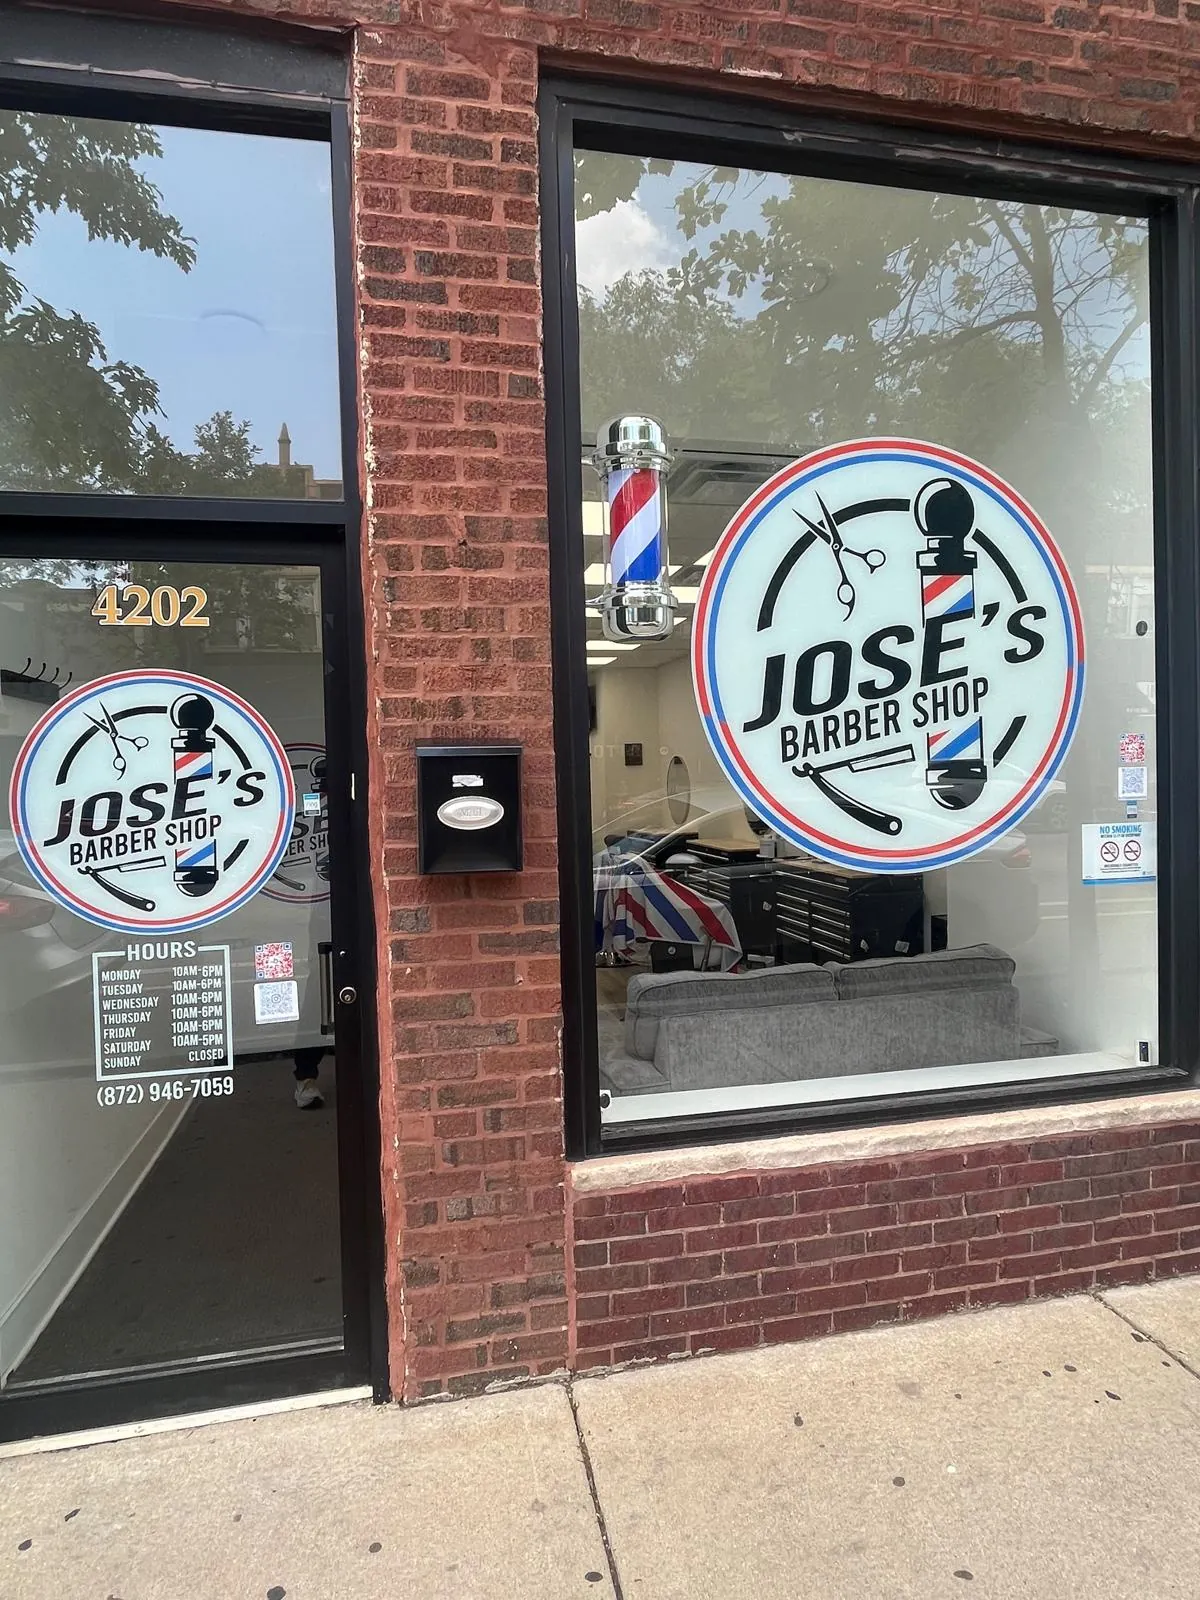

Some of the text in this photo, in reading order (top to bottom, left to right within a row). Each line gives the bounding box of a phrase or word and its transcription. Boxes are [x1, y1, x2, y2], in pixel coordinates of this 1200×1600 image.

[91, 585, 210, 627] 4202
[743, 601, 1047, 733] JOSE'S
[780, 677, 989, 763] BARBER SHOP
[44, 769, 266, 847] JOSE'S
[1099, 824, 1142, 834] NO SMOKING
[70, 814, 222, 866] BARBER SHOP
[127, 940, 196, 961] HOURS
[101, 965, 223, 982] MONDAY 10AM-6PM
[102, 978, 222, 996] TUESDAY 10AM-6PM
[102, 991, 223, 1010] WEDNESDAY 10AM-6PM
[103, 1005, 223, 1025] THURSDAY 10AM-6PM
[103, 1019, 223, 1039] FRIDAY 10AM-6PM
[103, 1033, 223, 1054] SATURDAY 10AM-5PM
[104, 1048, 224, 1069] SUNDAY CLOSED
[96, 1076, 234, 1106] (872) 946-7059
